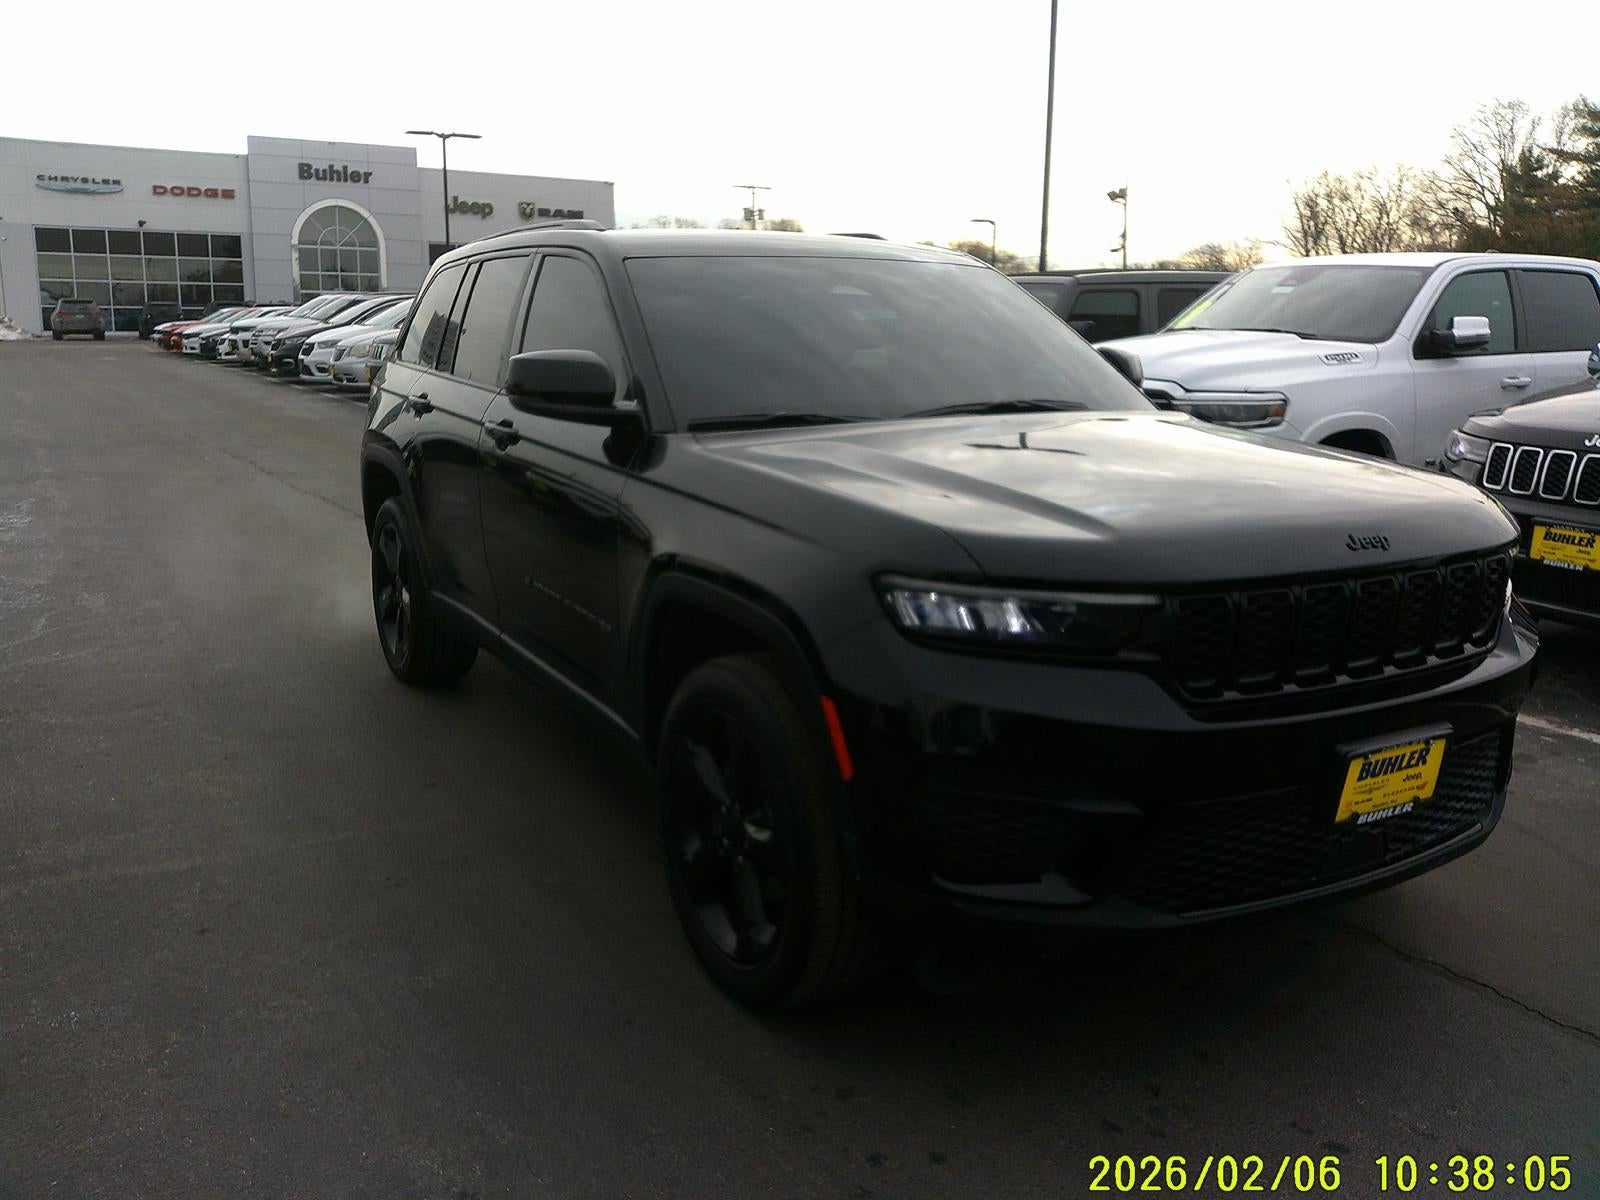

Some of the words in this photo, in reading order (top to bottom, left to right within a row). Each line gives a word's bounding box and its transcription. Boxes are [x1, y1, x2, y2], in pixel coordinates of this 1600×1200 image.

[36, 174, 122, 186] CHRYSLER
[298, 162, 373, 184] Buhler
[152, 184, 236, 200] DODGE
[448, 195, 494, 219] Jeep
[537, 207, 585, 220] RAM
[1345, 533, 1391, 552] Jeep
[1543, 530, 1596, 549] BUHLER
[1357, 747, 1431, 782] BUHLER
[1402, 772, 1422, 783] Jeep
[1357, 802, 1414, 824] BUHLER
